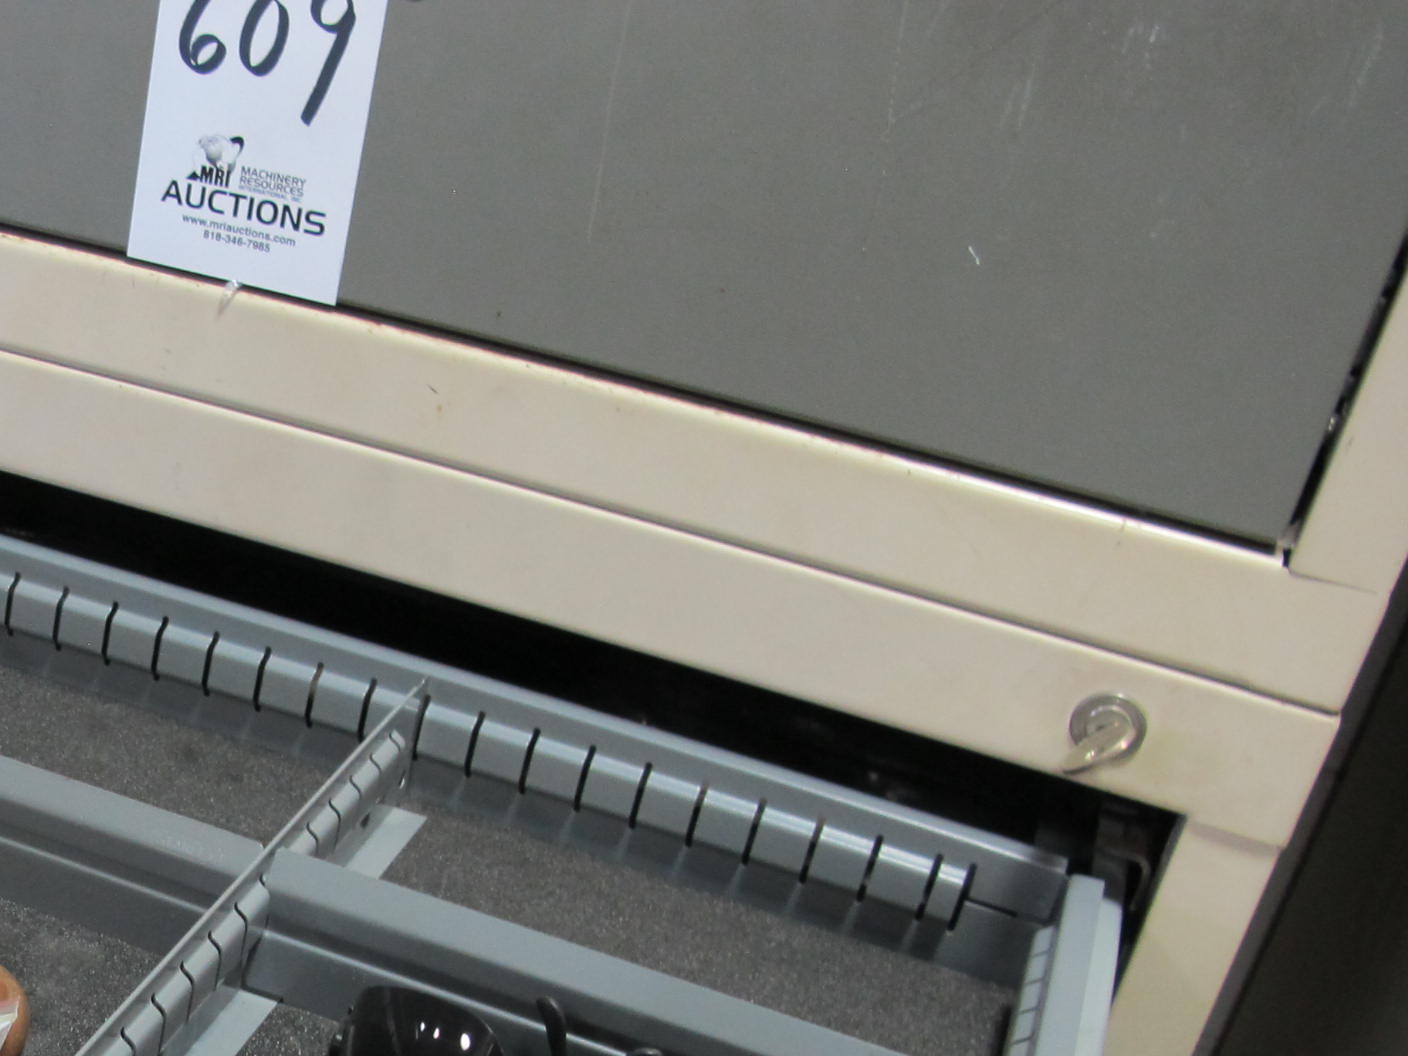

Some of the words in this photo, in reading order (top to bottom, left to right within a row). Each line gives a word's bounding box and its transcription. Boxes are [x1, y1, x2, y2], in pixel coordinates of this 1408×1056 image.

[179, 0, 356, 126] 609
[200, 165, 231, 188] MRI
[241, 166, 306, 186] MACHINERY
[239, 177, 304, 197] RESOURCES
[161, 180, 327, 236] AUCTIONS
[182, 214, 296, 247] www.mriauctions.com
